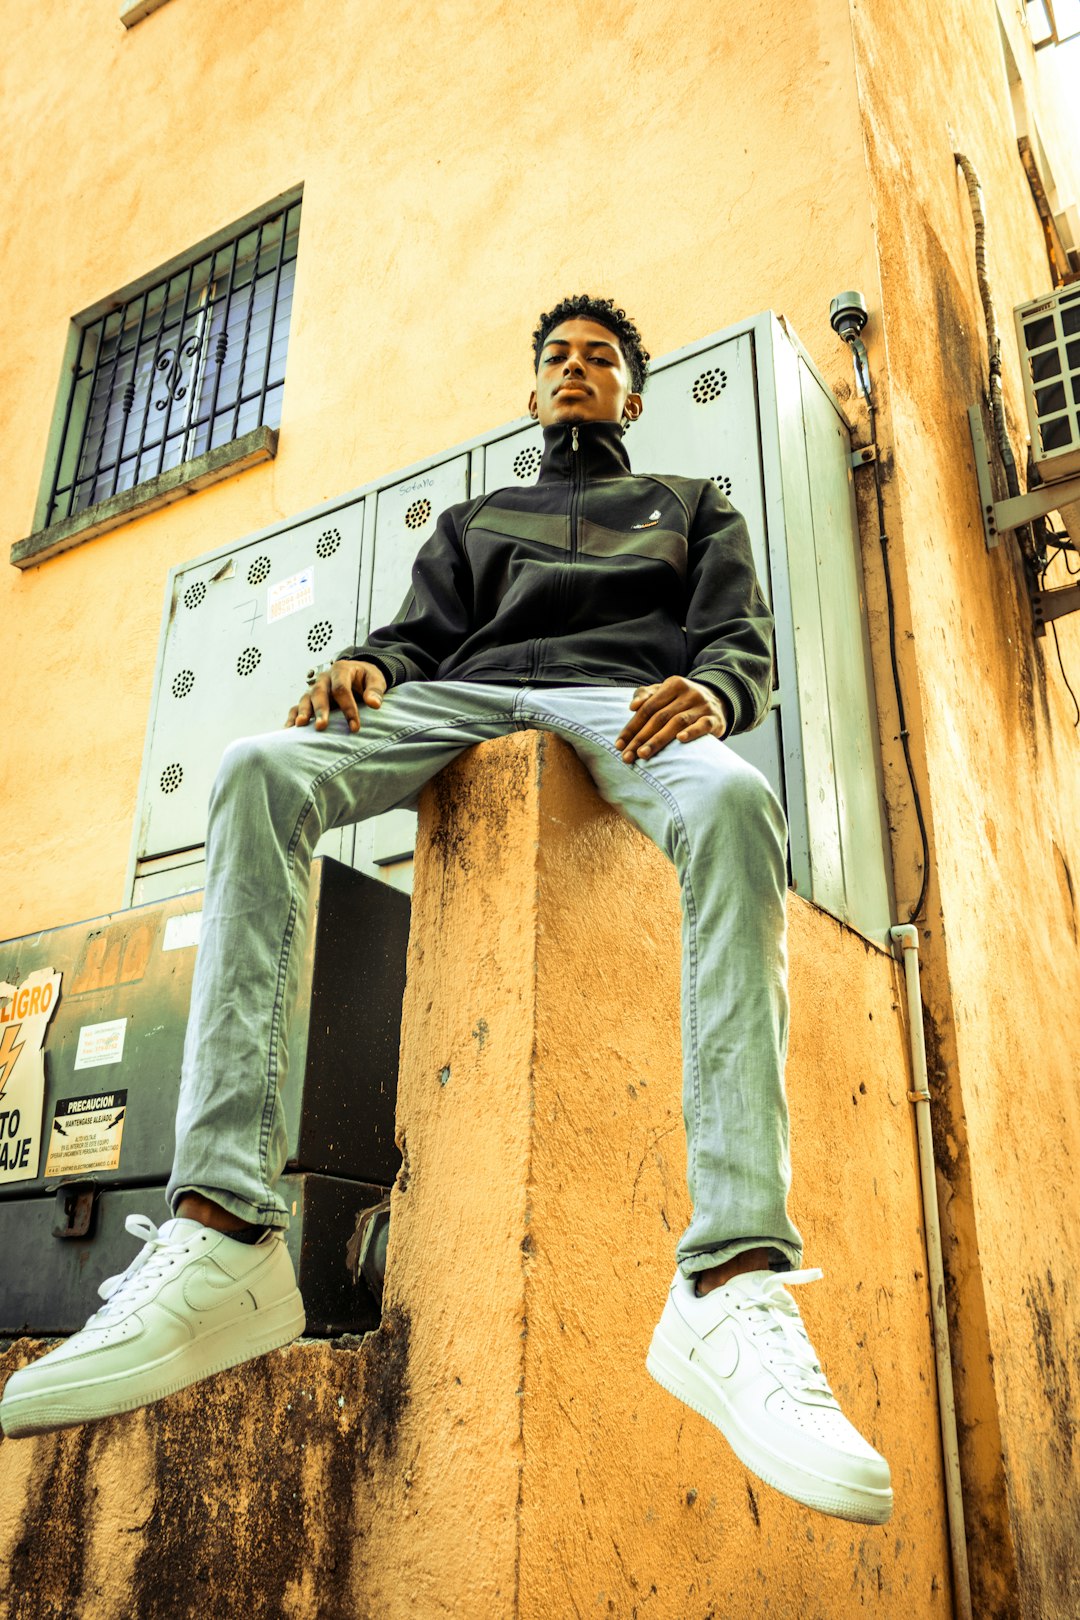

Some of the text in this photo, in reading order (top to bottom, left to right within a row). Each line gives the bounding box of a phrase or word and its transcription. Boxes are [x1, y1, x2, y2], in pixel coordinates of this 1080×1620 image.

[67, 1095, 114, 1113] PRECAUCION
[65, 1114, 112, 1127] MANTENGASE ALEJADO
[0, 1137, 32, 1171] AJE
